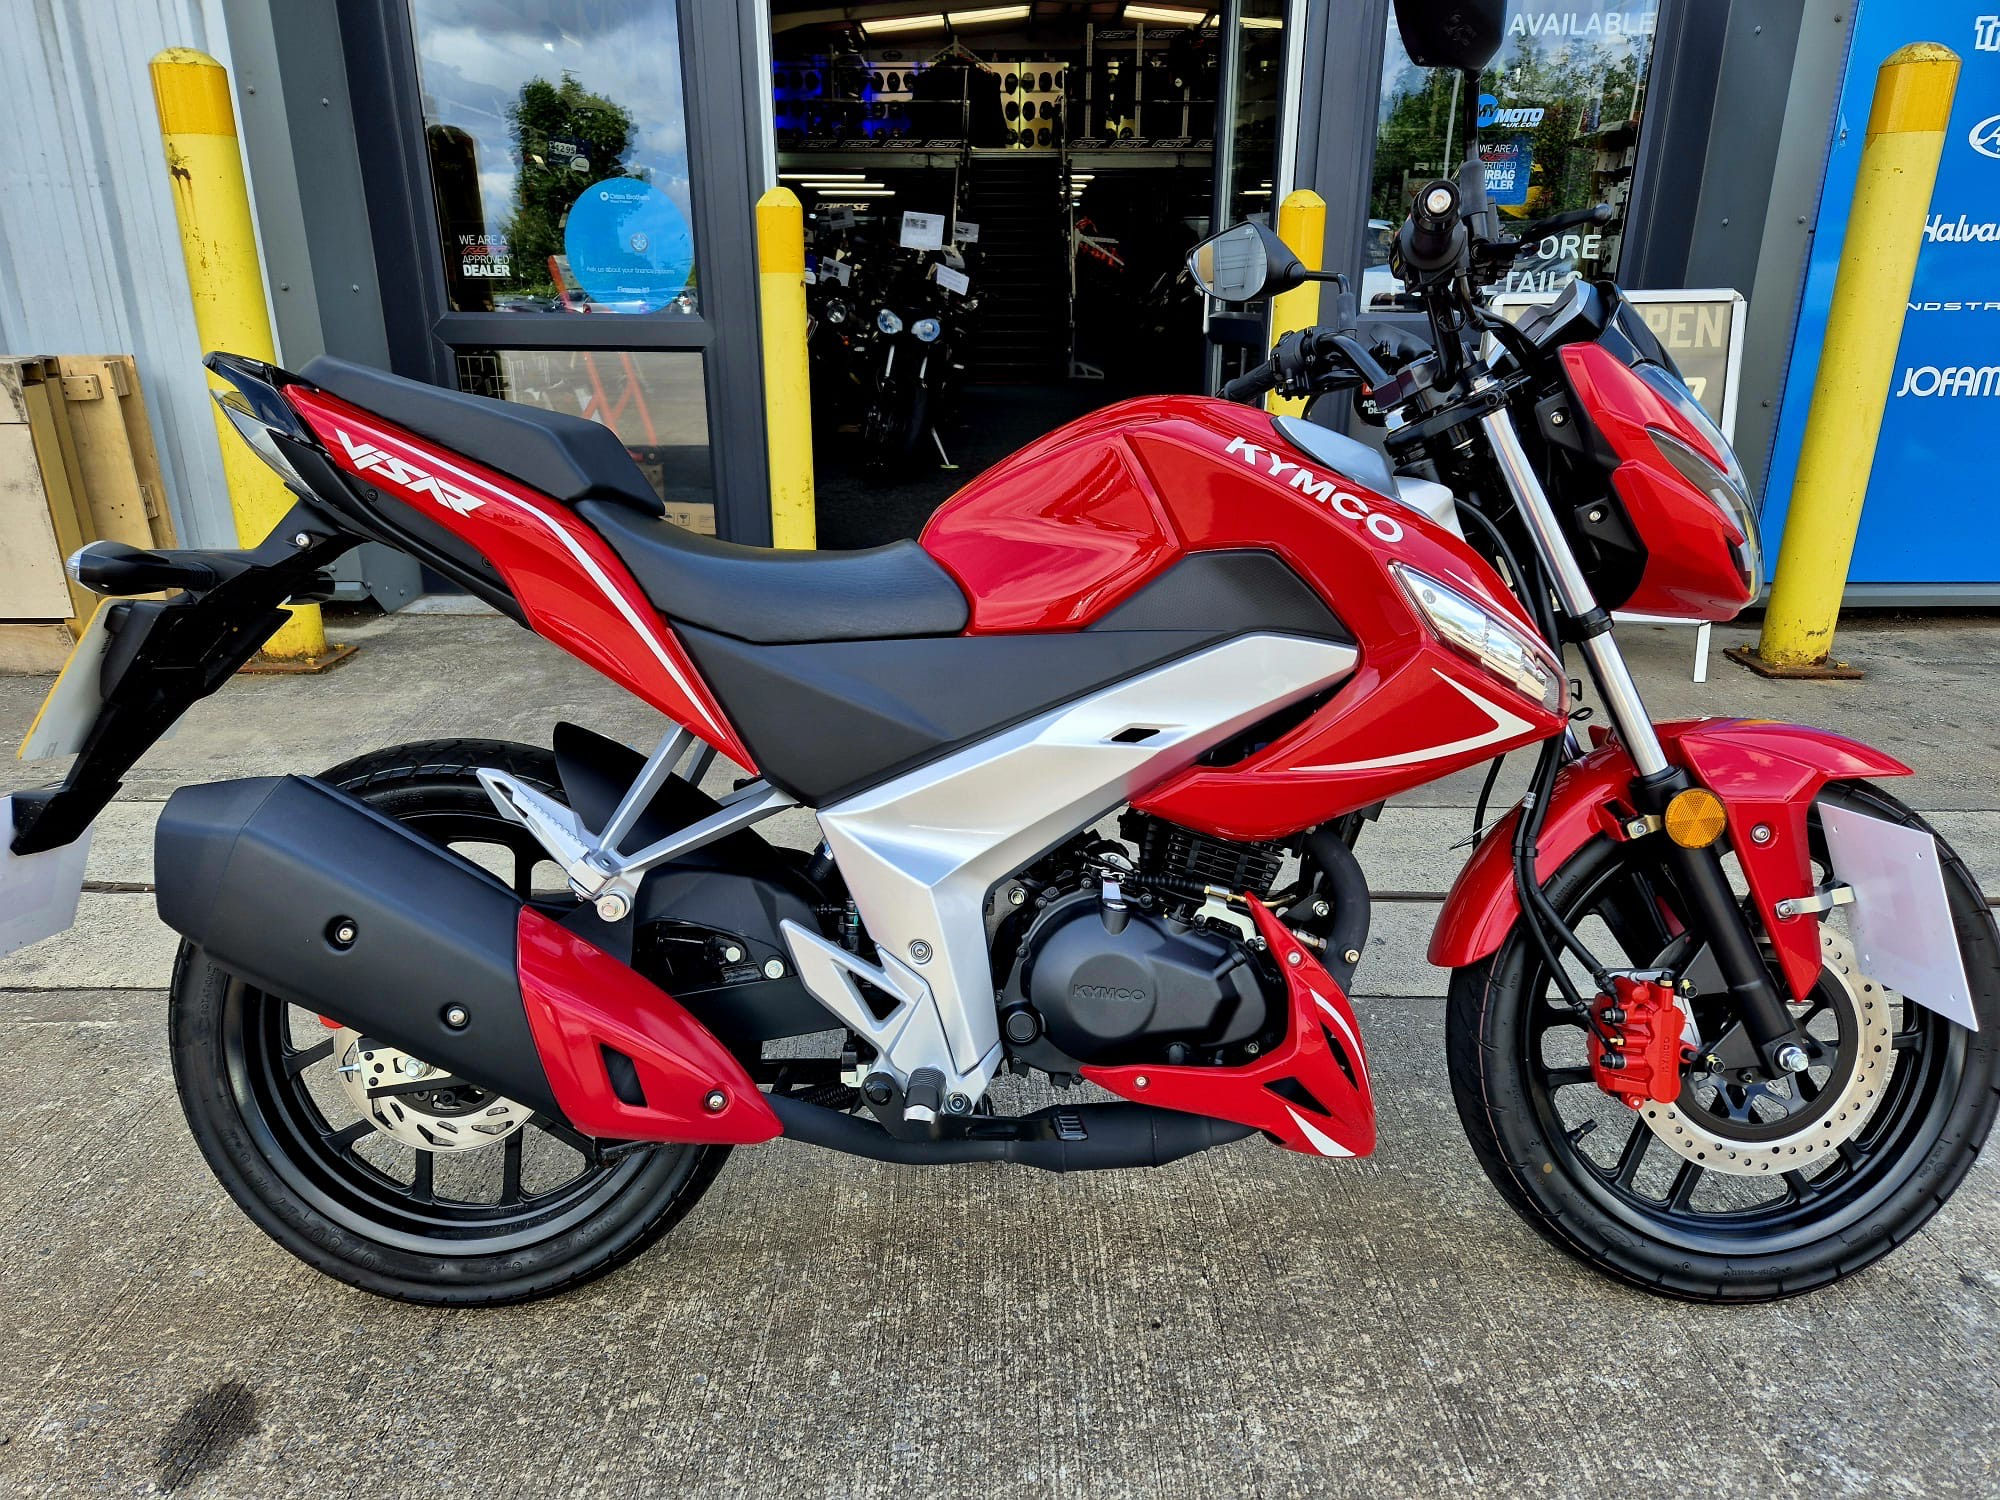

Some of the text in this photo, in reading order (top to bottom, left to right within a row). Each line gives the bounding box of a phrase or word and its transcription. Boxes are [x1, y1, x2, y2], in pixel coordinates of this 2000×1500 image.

[1507, 12, 1656, 36] AVAILABLE
[1495, 108, 1544, 123] MOTO
[1480, 144, 1519, 153] WE ARE A
[1485, 170, 1515, 180] IRBAG
[1486, 181, 1514, 190] EALER
[1923, 214, 2000, 242] Halva
[459, 235, 507, 245] WE ARE A
[1537, 234, 1601, 260] ORE
[463, 255, 510, 264] APPROVED
[463, 265, 511, 277] DEALER
[1481, 270, 1583, 295] TAIL
[1640, 306, 1724, 348] PEN
[335, 428, 487, 519] VISAR
[1225, 436, 1404, 543] KYMCO
[1072, 984, 1146, 1001] KYMCO
